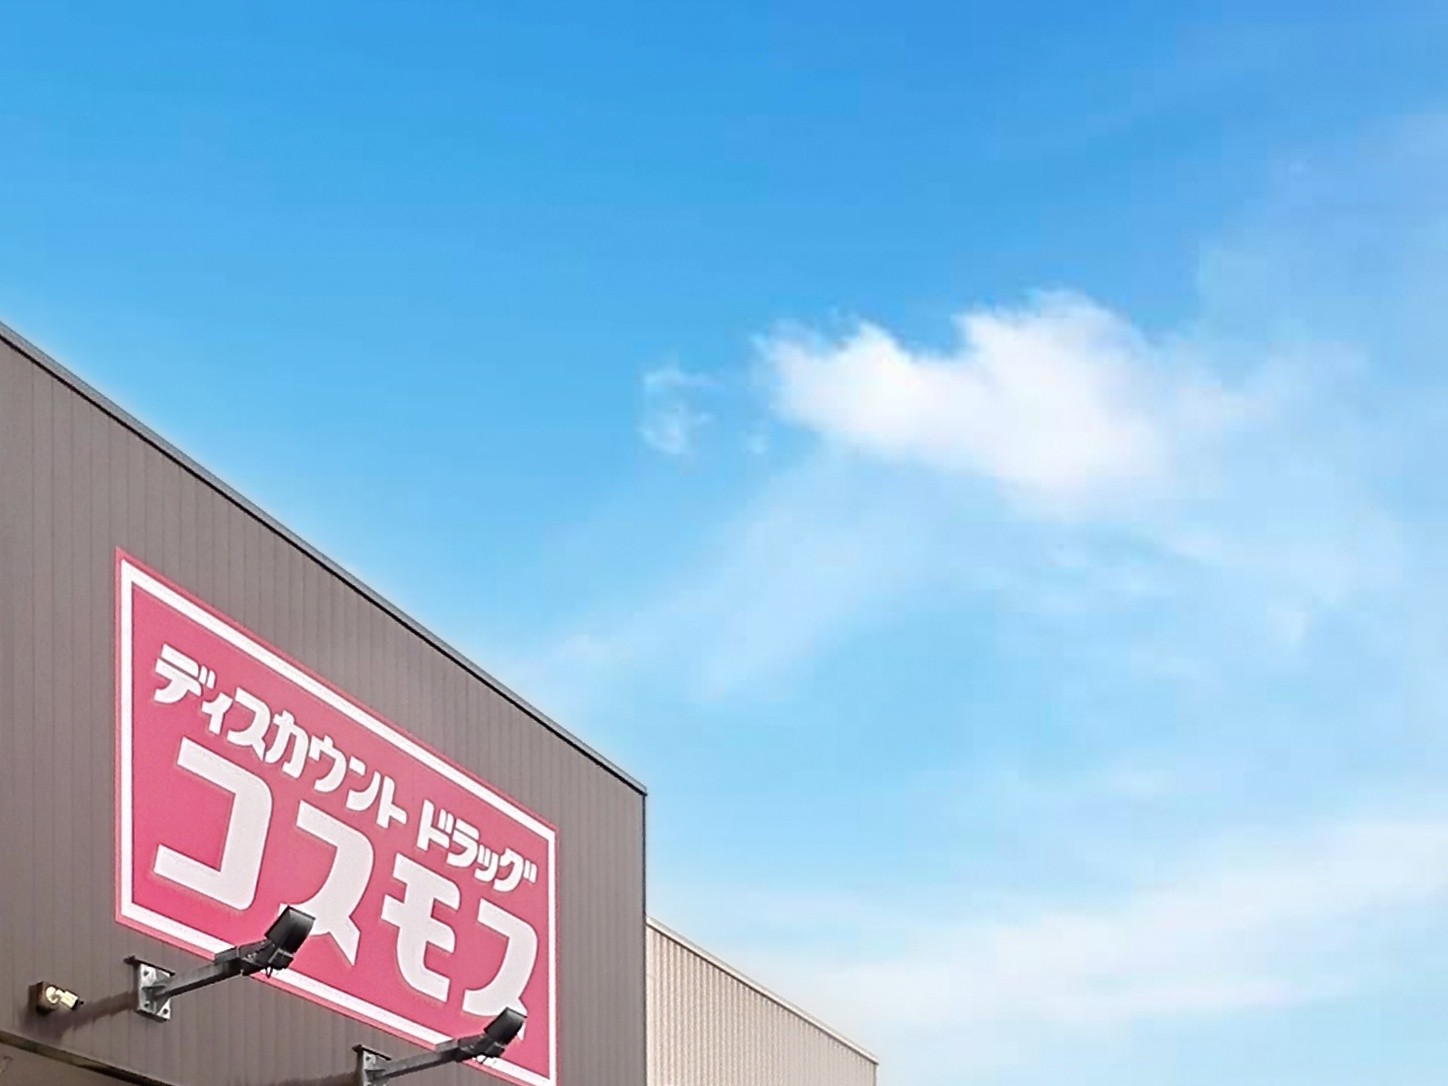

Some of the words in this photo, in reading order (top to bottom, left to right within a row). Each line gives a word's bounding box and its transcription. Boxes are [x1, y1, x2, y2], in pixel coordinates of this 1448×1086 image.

[153, 644, 407, 828] ディスカウント
[416, 799, 537, 892] ドラッグ
[154, 736, 539, 1039] コスモス
